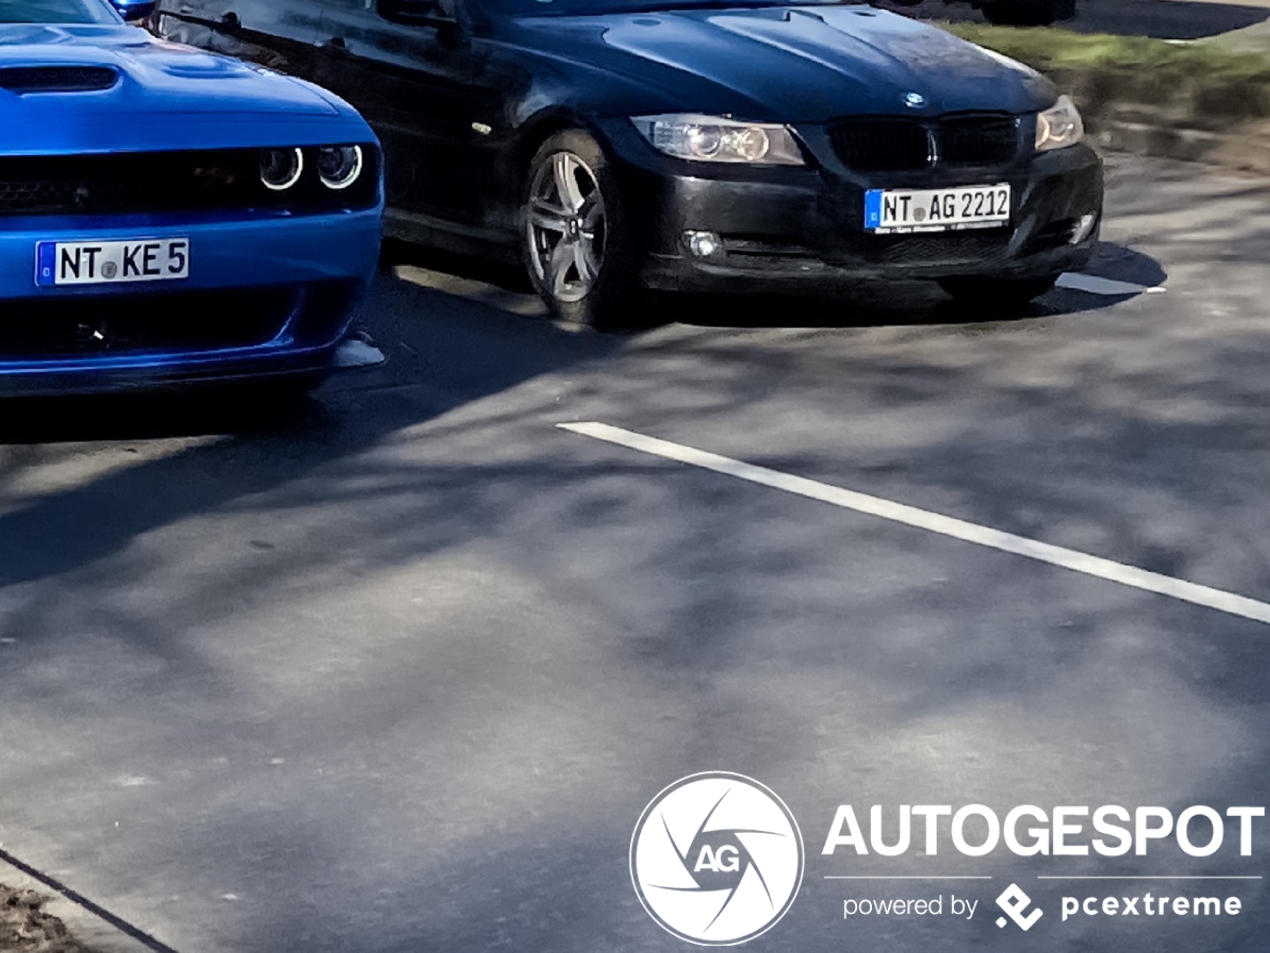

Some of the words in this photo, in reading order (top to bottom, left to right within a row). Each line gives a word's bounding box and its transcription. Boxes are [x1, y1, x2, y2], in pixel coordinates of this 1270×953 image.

[883, 195, 912, 222] NT
[929, 193, 956, 219] AG
[961, 190, 1008, 218] 2212
[60, 247, 102, 279] NT
[122, 243, 161, 277] KE
[167, 242, 187, 273] 5
